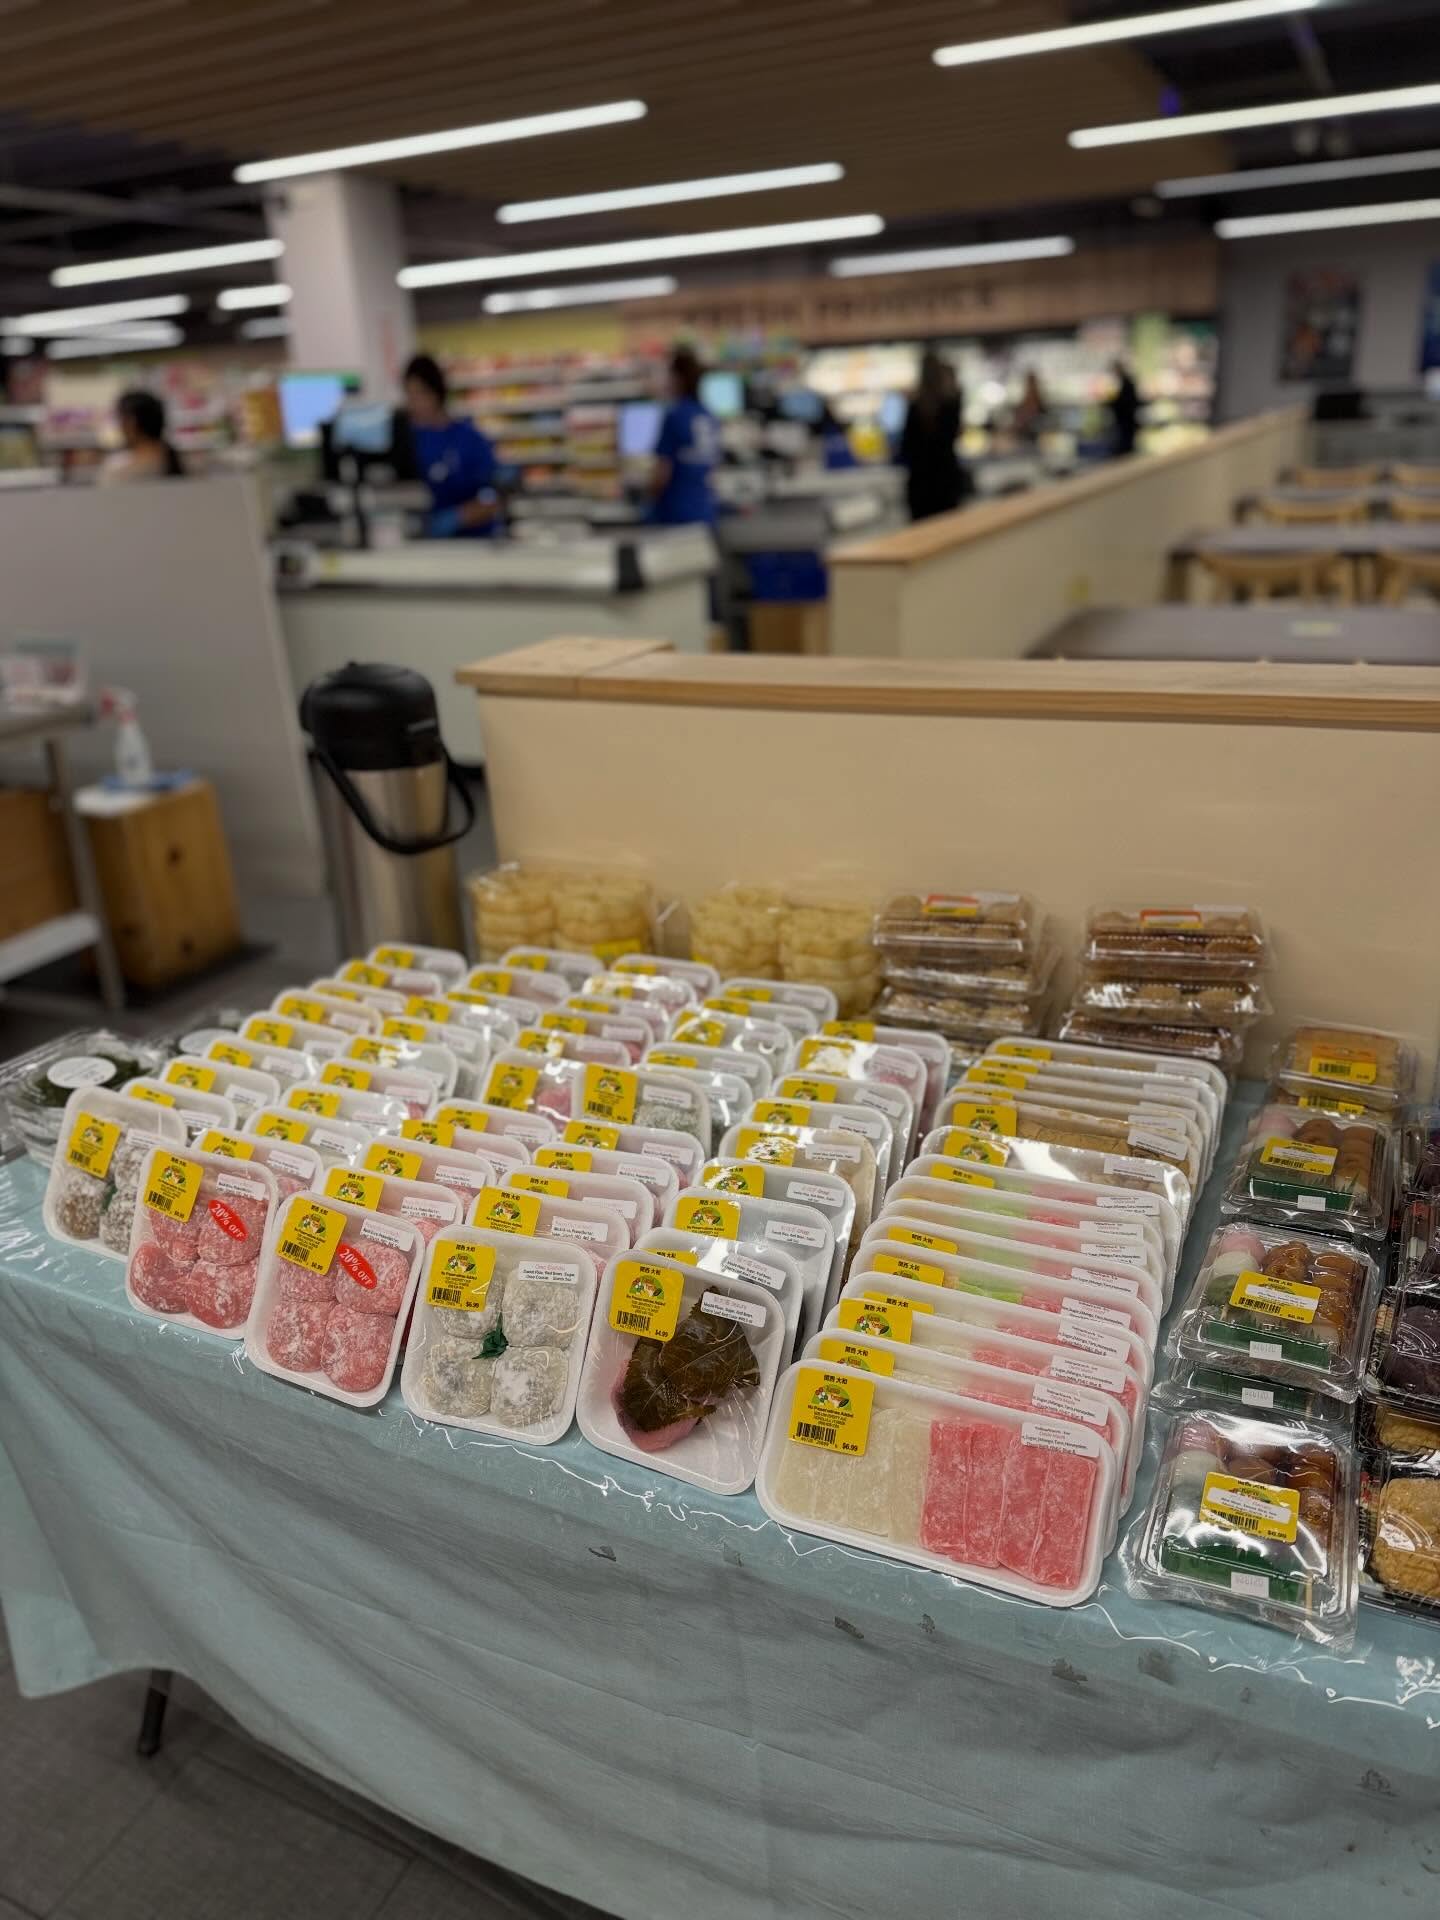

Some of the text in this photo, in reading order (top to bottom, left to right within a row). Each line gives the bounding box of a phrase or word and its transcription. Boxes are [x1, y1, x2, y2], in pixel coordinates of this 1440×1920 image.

[211, 1203, 245, 1238] 20% OFF
[339, 1248, 373, 1285] 20% OFF
[655, 1329, 669, 1338] $4.99
[842, 1442, 859, 1452] $6.99
